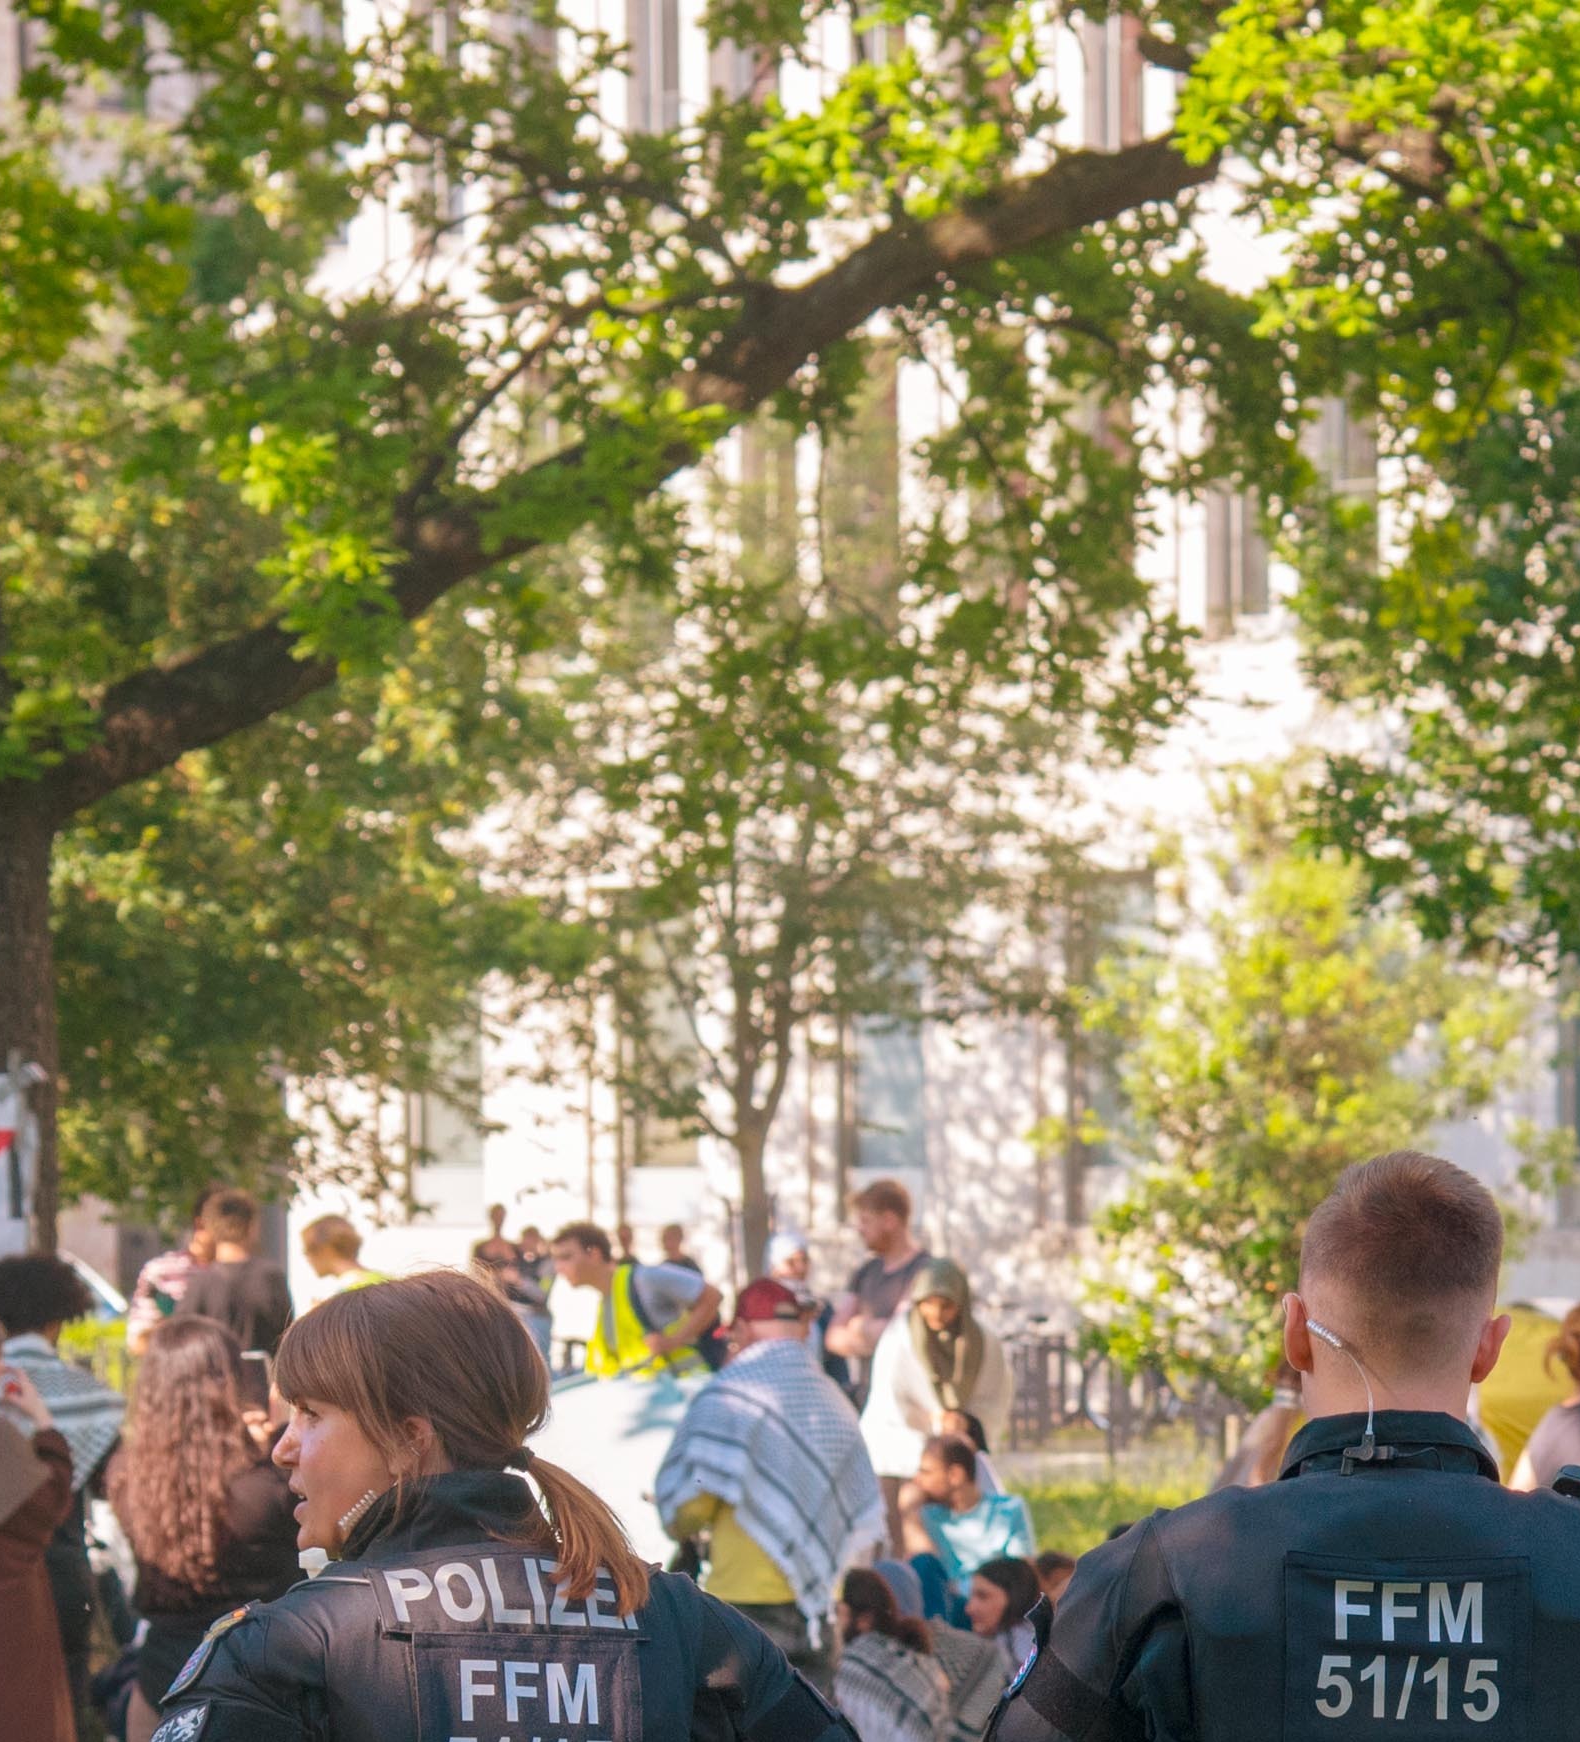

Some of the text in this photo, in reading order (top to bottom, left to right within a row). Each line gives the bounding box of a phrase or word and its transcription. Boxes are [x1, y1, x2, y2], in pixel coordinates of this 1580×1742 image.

[1335, 1580, 1483, 1644] FFM
[460, 1659, 599, 1725] FFM
[1315, 1655, 1500, 1722] 51/15
